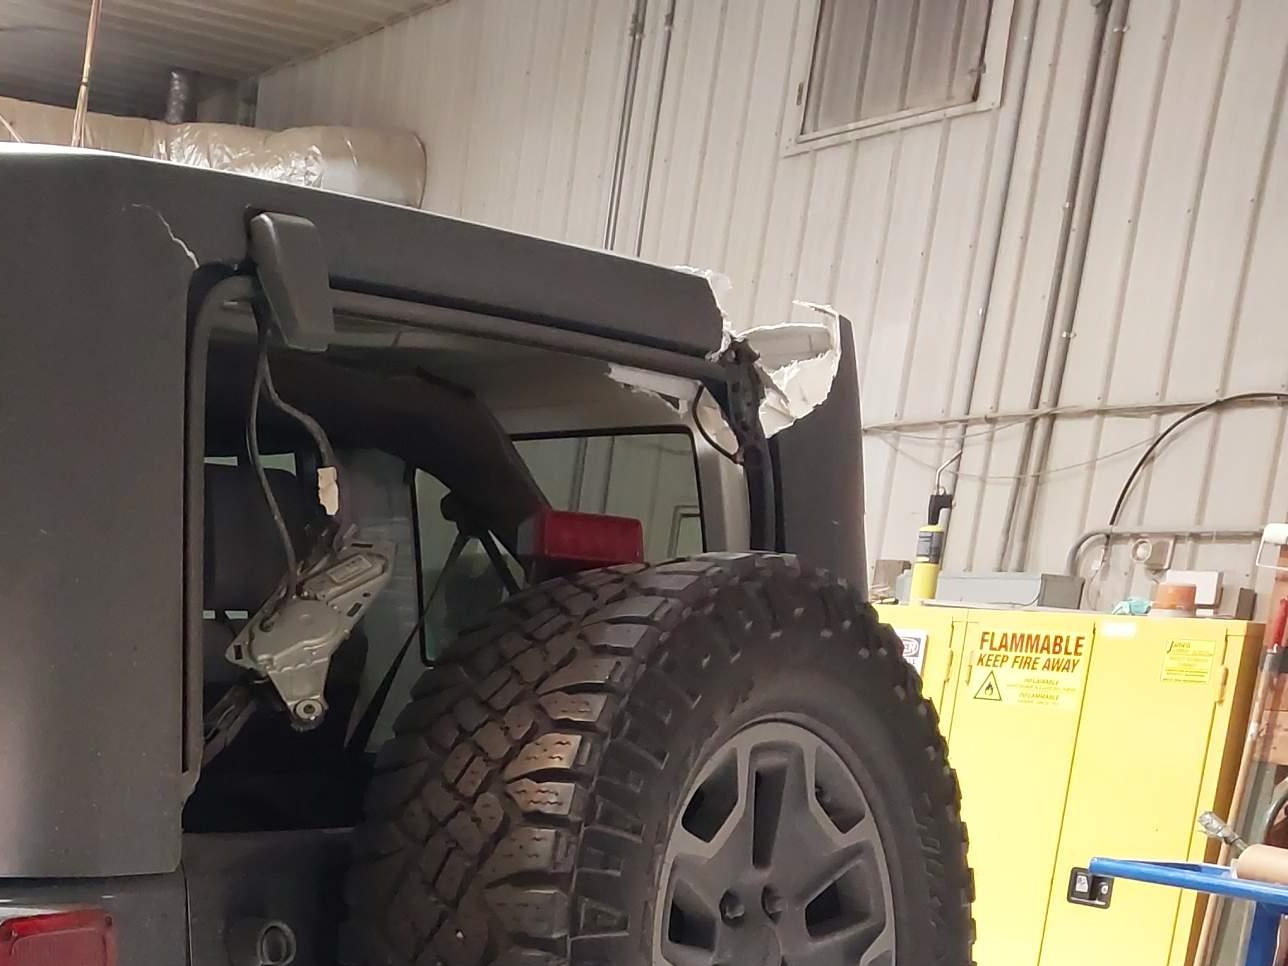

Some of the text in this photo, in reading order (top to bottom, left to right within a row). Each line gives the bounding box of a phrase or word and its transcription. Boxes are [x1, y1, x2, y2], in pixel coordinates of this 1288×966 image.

[979, 632, 1086, 656] FLAMMABLE
[977, 653, 1080, 673] KEEP FIRE AWAY
